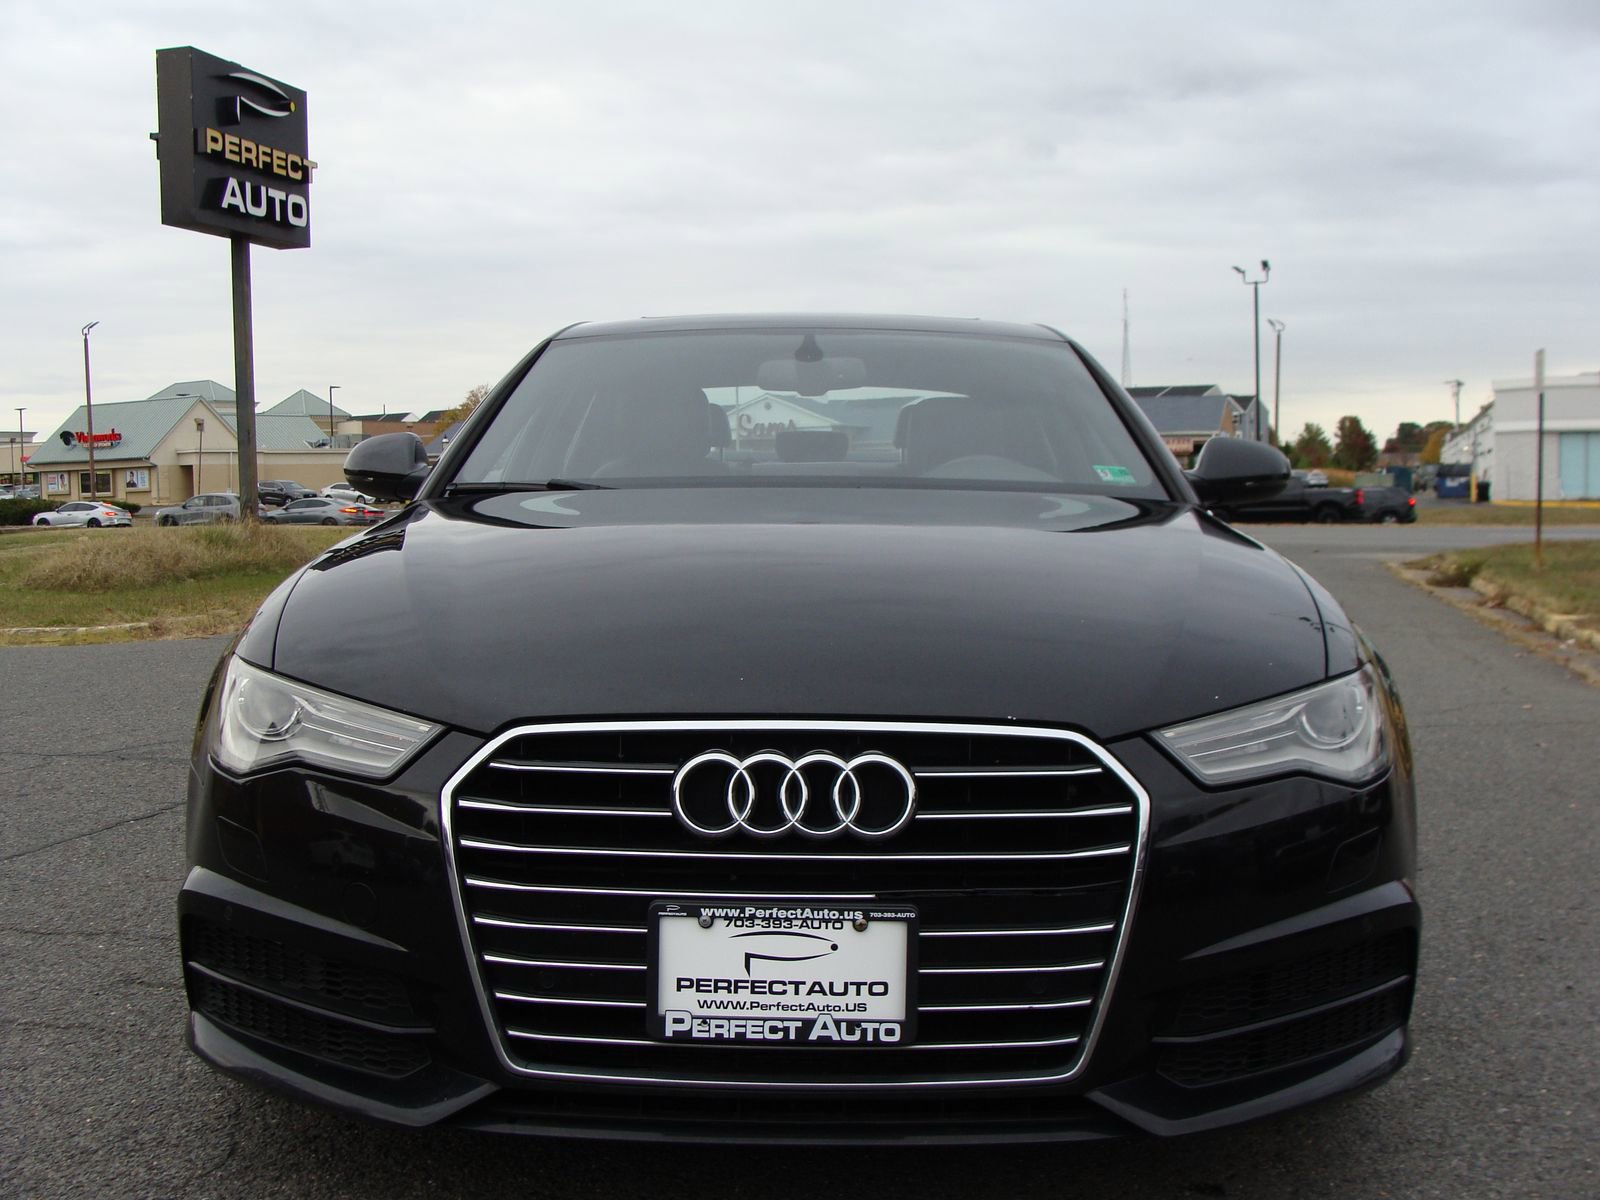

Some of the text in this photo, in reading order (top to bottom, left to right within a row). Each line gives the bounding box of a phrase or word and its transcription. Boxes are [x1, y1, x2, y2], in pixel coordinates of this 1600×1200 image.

[206, 127, 318, 184] PERFECT
[221, 176, 308, 228] AUTO
[701, 907, 864, 921] www.PerfectAuto.us
[724, 918, 844, 930] 703-393-AUTO
[676, 976, 889, 997] PERFECTAUTO
[665, 1010, 901, 1042] PERFECT AUTO
